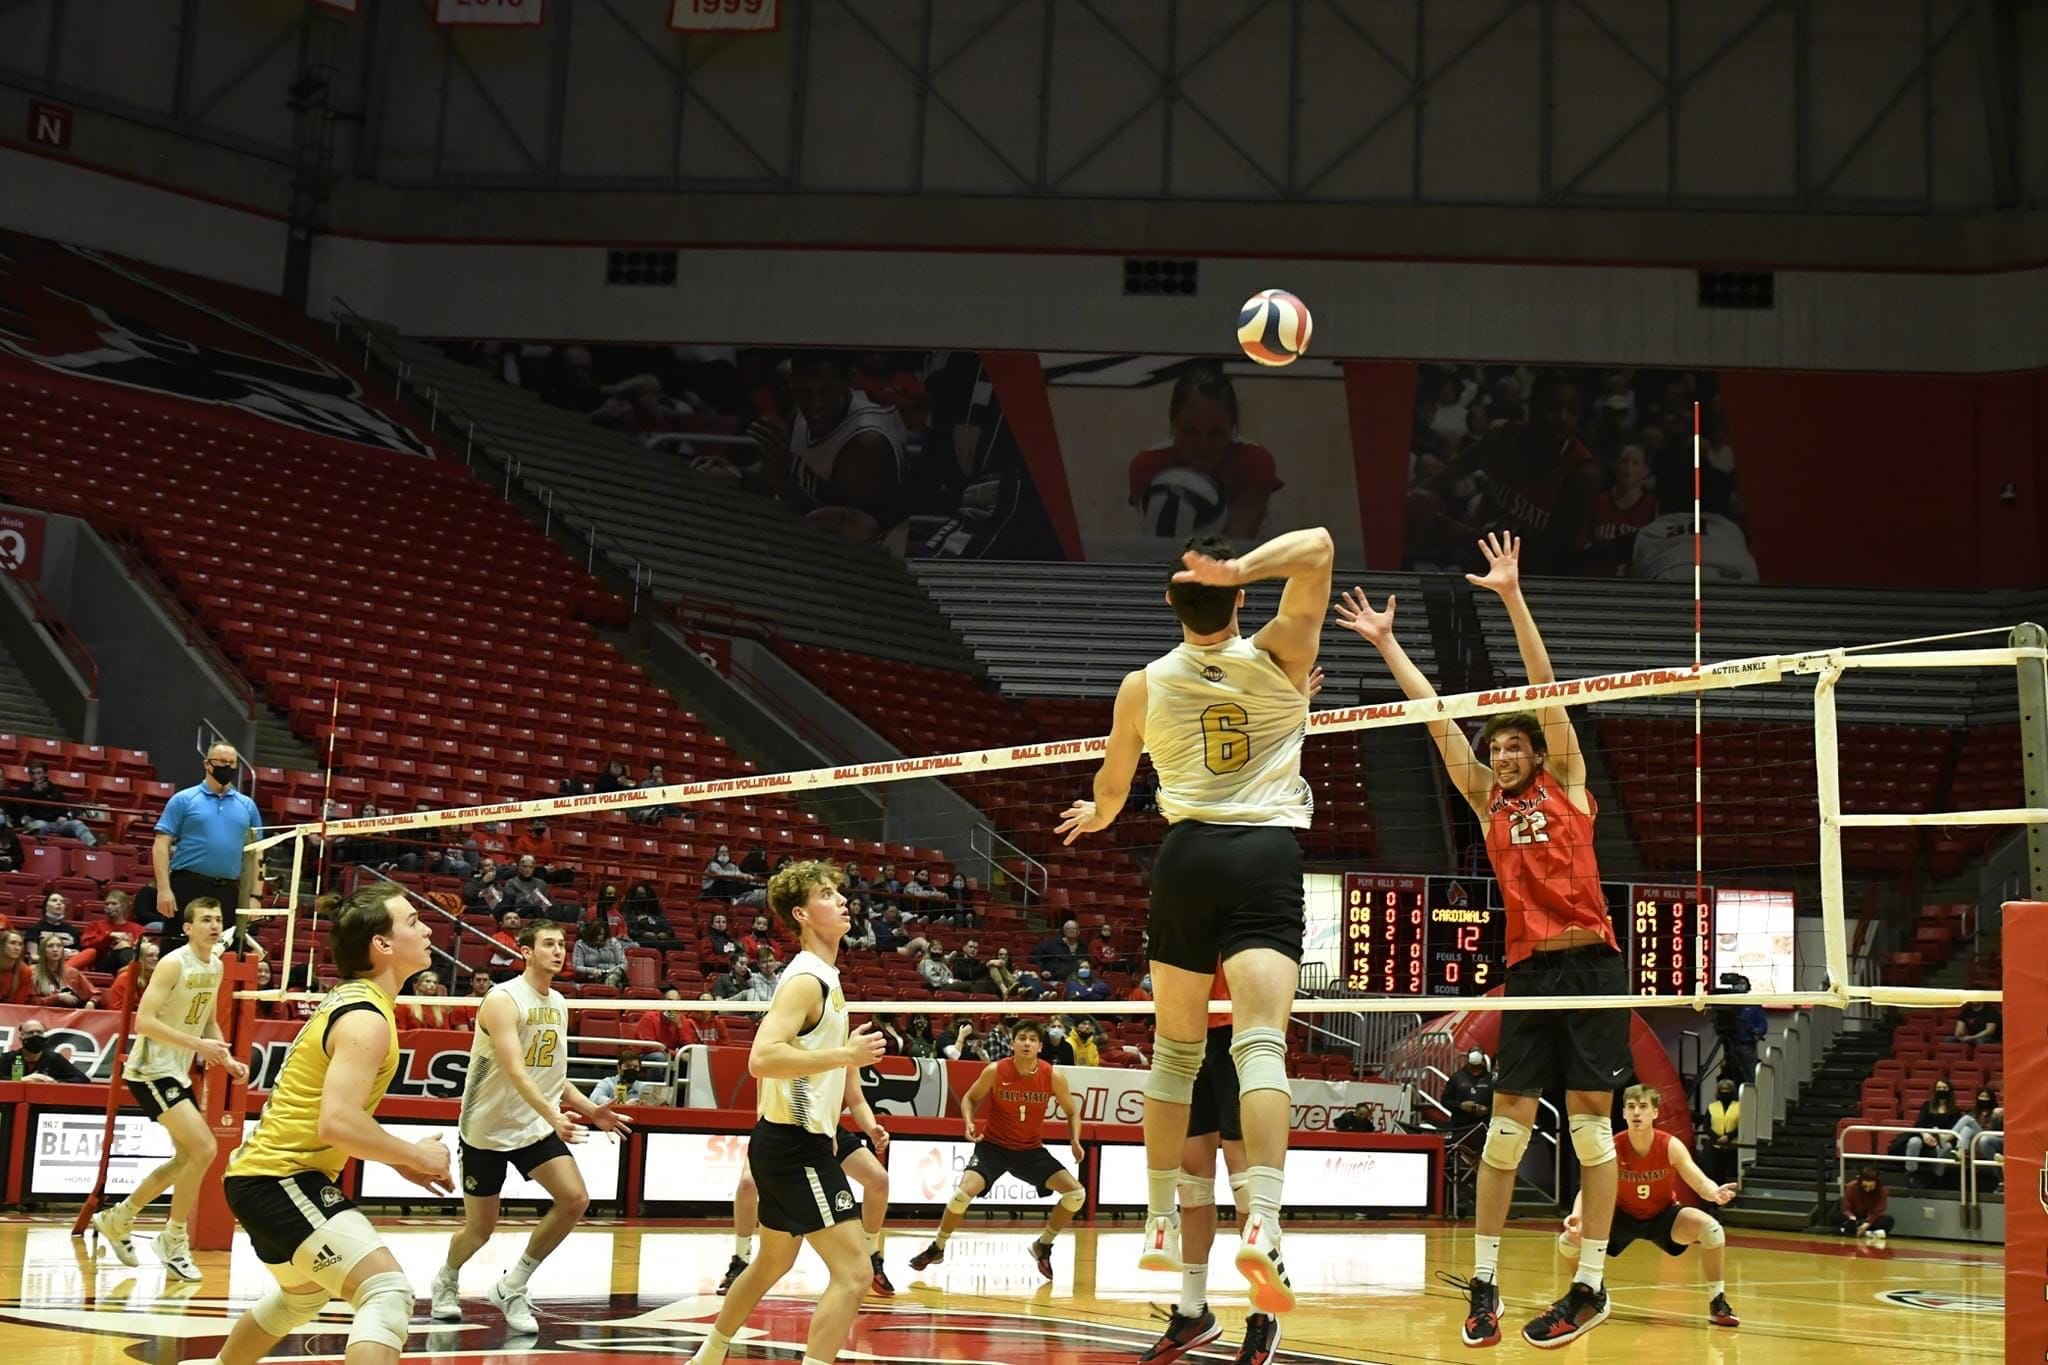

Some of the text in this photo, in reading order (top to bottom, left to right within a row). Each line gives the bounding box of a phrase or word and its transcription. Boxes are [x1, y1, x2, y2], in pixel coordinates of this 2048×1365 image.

[37, 114, 61, 145] N
[1711, 661, 1767, 675] ACTIVE ANKLE
[1477, 690, 1521, 707] BALL
[1525, 680, 1580, 701] STATE
[1309, 704, 1406, 727] VOLLEYBALL
[1200, 702, 1250, 775] 6
[1011, 746, 1041, 761] BALL
[1044, 741, 1081, 757] STATE
[833, 756, 963, 780] BALL STATE VOLLEYBALL
[683, 775, 793, 796] BALL STATE VOLLEYBALL
[553, 791, 648, 809] BALL STATE VOLLEYBALL
[440, 804, 523, 820] BALL STATE VOLLEYBALL
[1509, 810, 1550, 846] 22
[1378, 879, 1395, 888] KILLS
[1350, 889, 1422, 906] 01 0 1
[1349, 906, 1421, 925] 08 0 0
[1431, 908, 1491, 924] CARDINALS
[1636, 901, 1657, 917] 06
[1672, 903, 1683, 918] 0
[1349, 924, 1421, 940] 09 2 1
[1636, 917, 1657, 934] 07
[1672, 919, 1683, 934] 2
[1457, 926, 1480, 951] 12
[1641, 936, 1657, 950] 11
[1672, 937, 1683, 952] 0
[1353, 941, 1420, 958] 14 1 0
[1436, 952, 1462, 962] FOULS
[1353, 957, 1420, 975] 15 2 0
[1641, 953, 1657, 968] 12
[1672, 954, 1683, 969] 0
[1445, 962, 1489, 985] 0 2
[1641, 970, 1657, 984] 14
[1672, 971, 1683, 986] 0
[1348, 974, 1420, 992] 22 3 2
[1434, 984, 1460, 995] SCORE
[524, 1029, 558, 1068] 12
[1018, 1104, 1027, 1122] 1
[1636, 1183, 1650, 1200] 9
[312, 1255, 342, 1272] adidas
